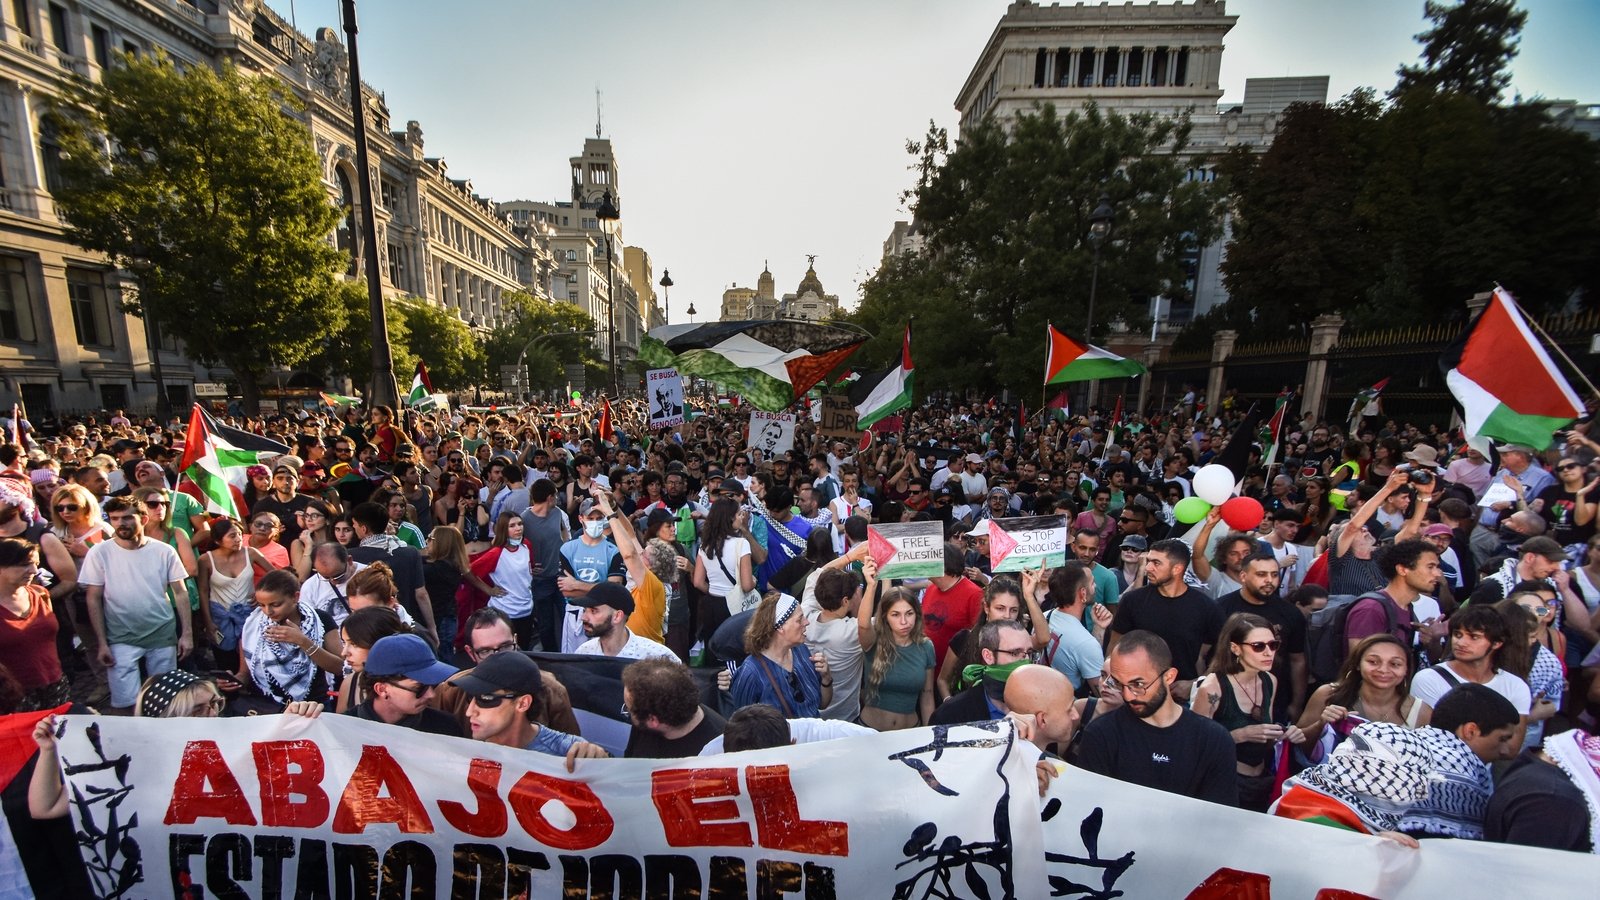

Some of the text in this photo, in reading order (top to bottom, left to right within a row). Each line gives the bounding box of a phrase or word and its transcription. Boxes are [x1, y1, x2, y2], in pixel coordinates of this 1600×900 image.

[659, 371, 678, 379] BUSCA
[755, 411, 792, 422] SE BUSCA
[651, 417, 684, 430] GENOCIDA
[902, 536, 931, 549] FREE
[1022, 530, 1055, 542] STOP
[1014, 540, 1062, 554] GENOCIDE
[163, 739, 849, 857] ABAJO EL
